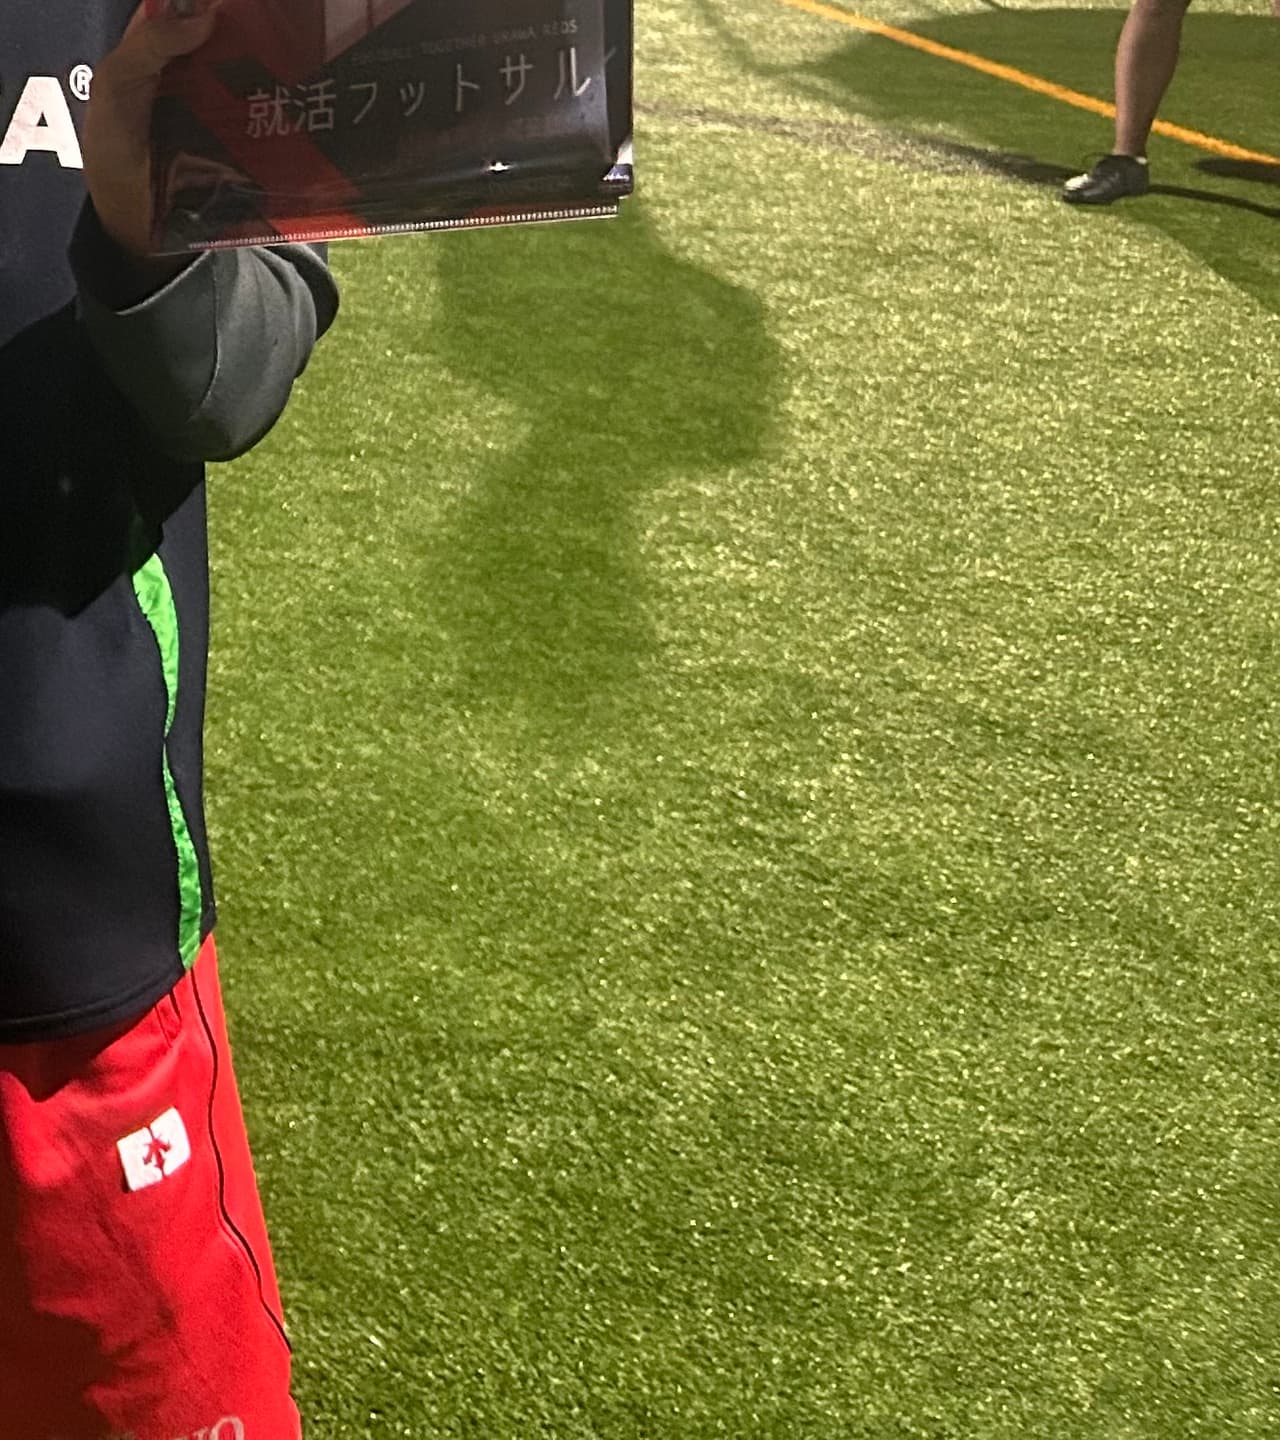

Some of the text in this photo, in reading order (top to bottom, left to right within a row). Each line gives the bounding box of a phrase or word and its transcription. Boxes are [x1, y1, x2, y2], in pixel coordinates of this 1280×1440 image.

[246, 45, 591, 139] 就活フットサル
